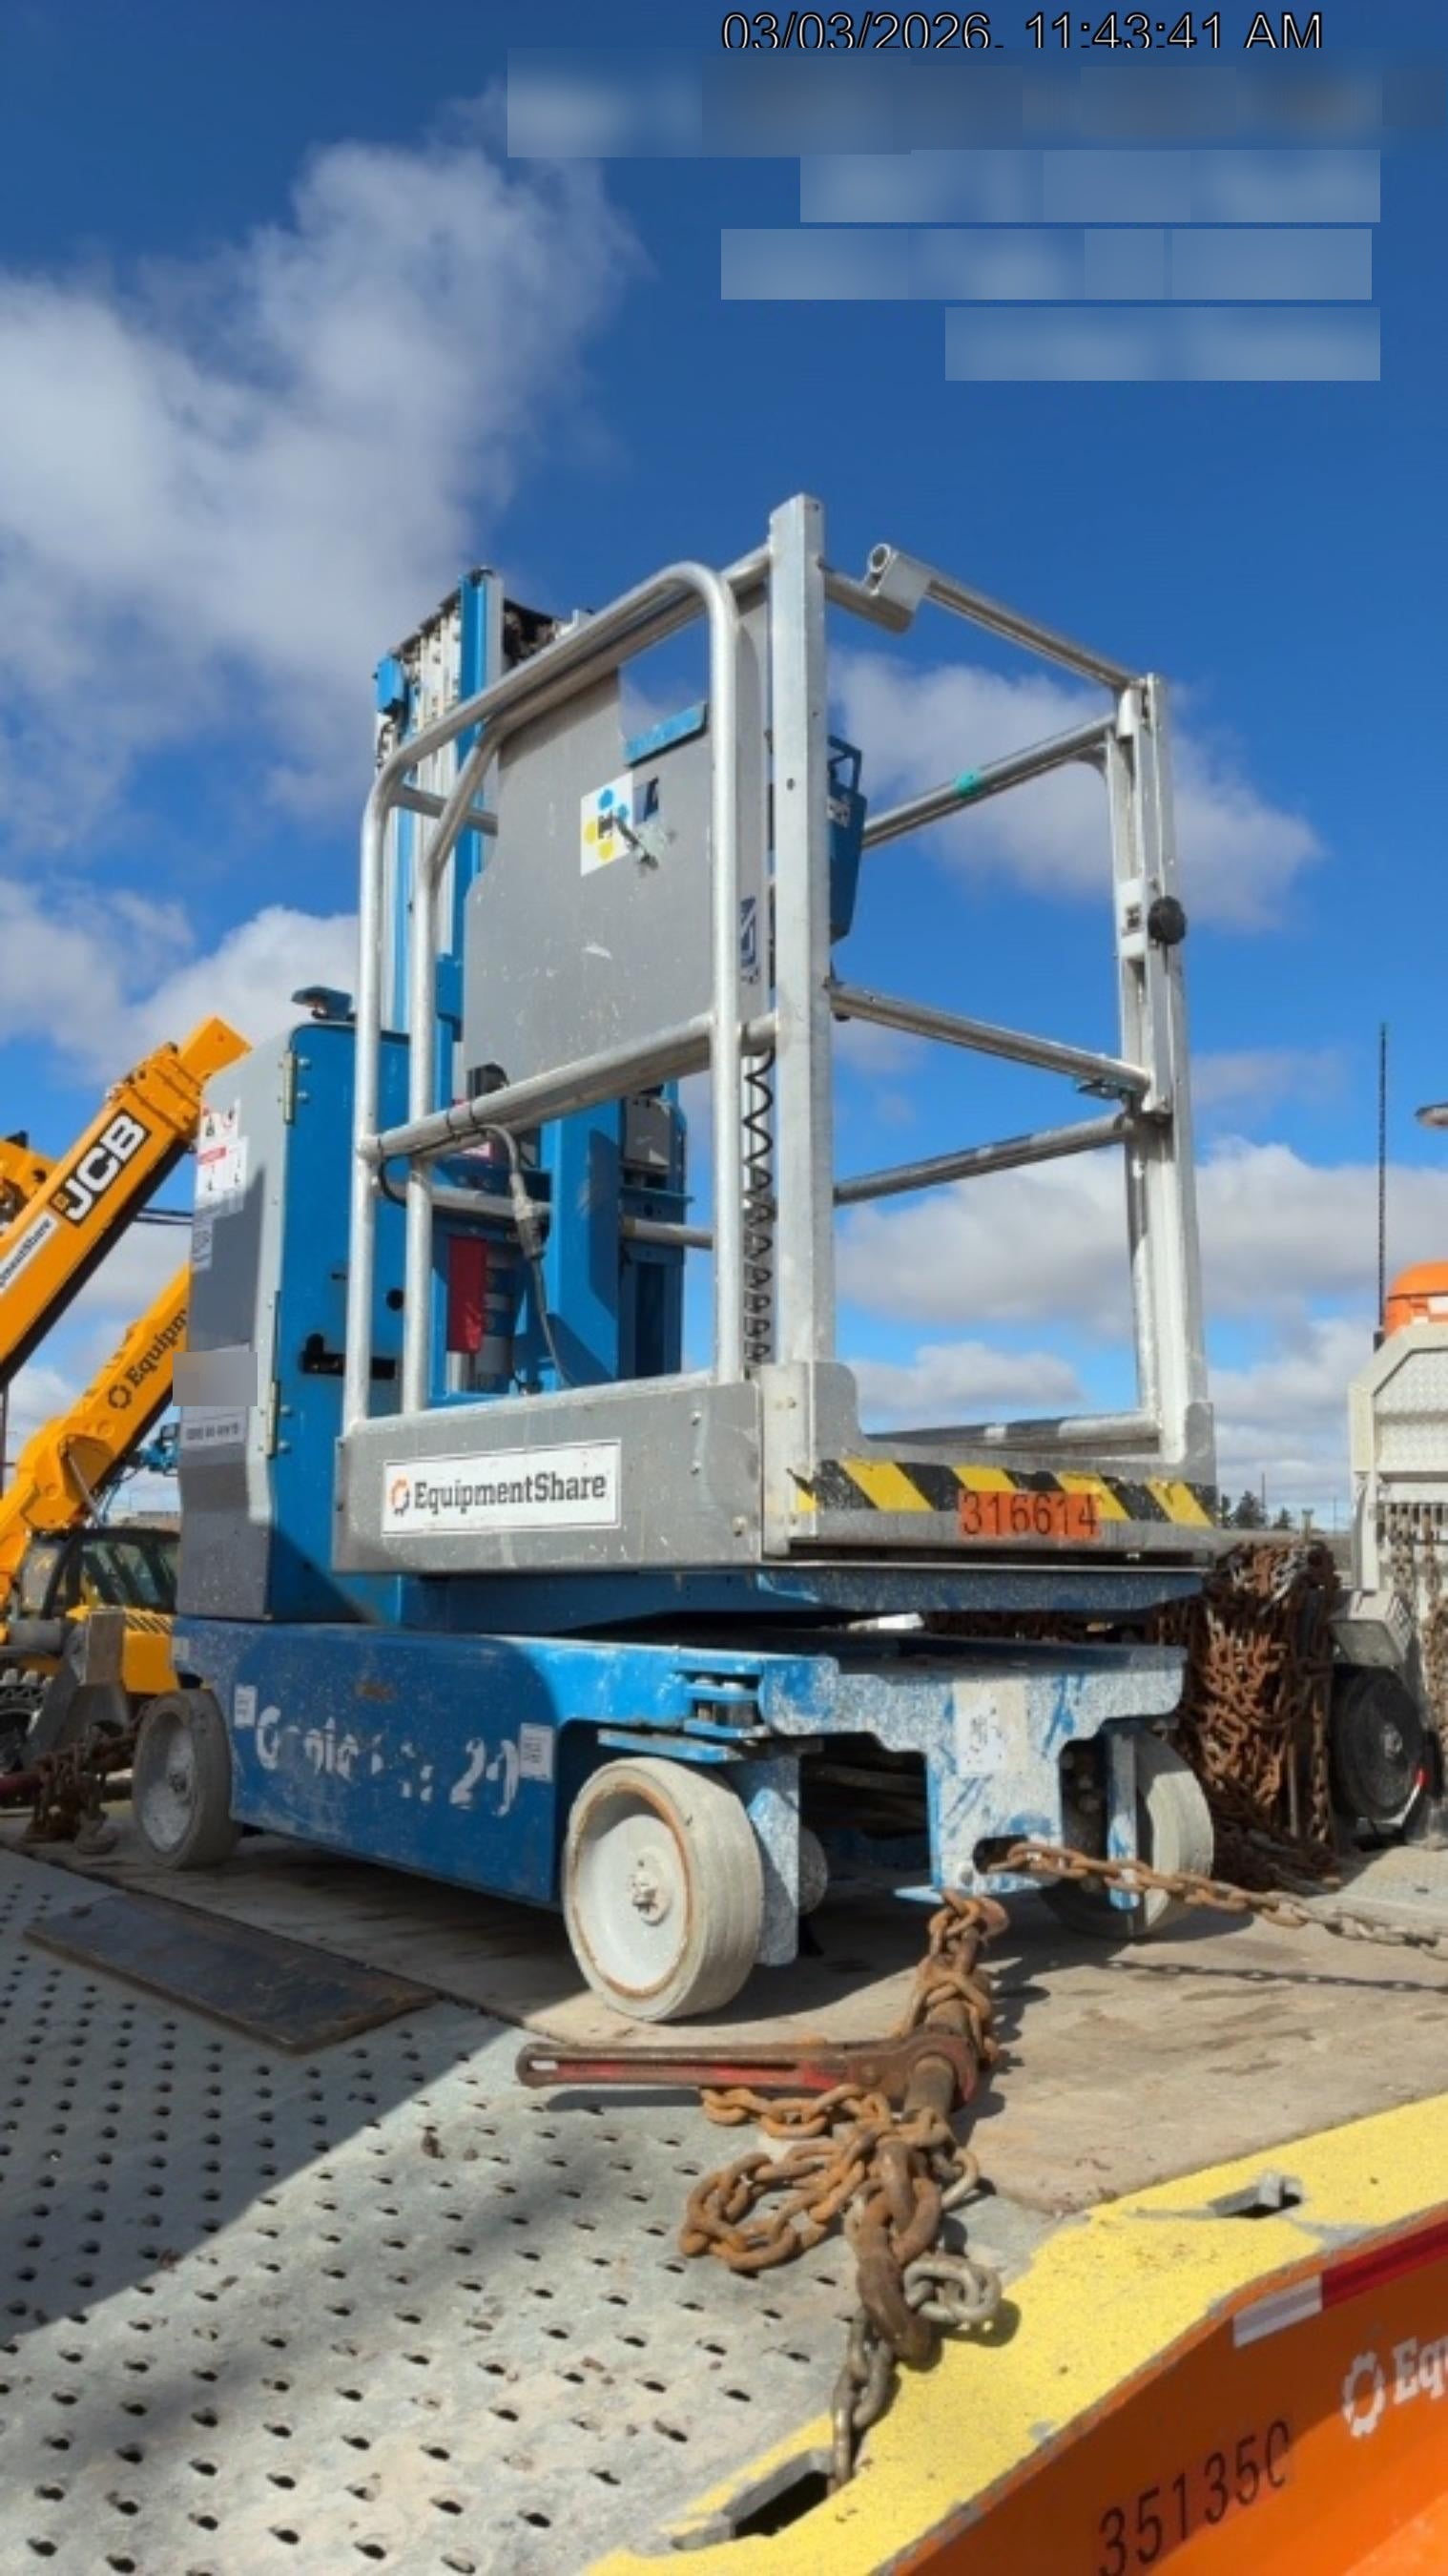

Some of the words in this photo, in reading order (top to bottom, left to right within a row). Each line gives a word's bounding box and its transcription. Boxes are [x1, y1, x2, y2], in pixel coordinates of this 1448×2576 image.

[65, 1114, 146, 1221] JCB
[414, 1472, 607, 1515] EquipmentShare
[962, 1489, 1098, 1537] 316614
